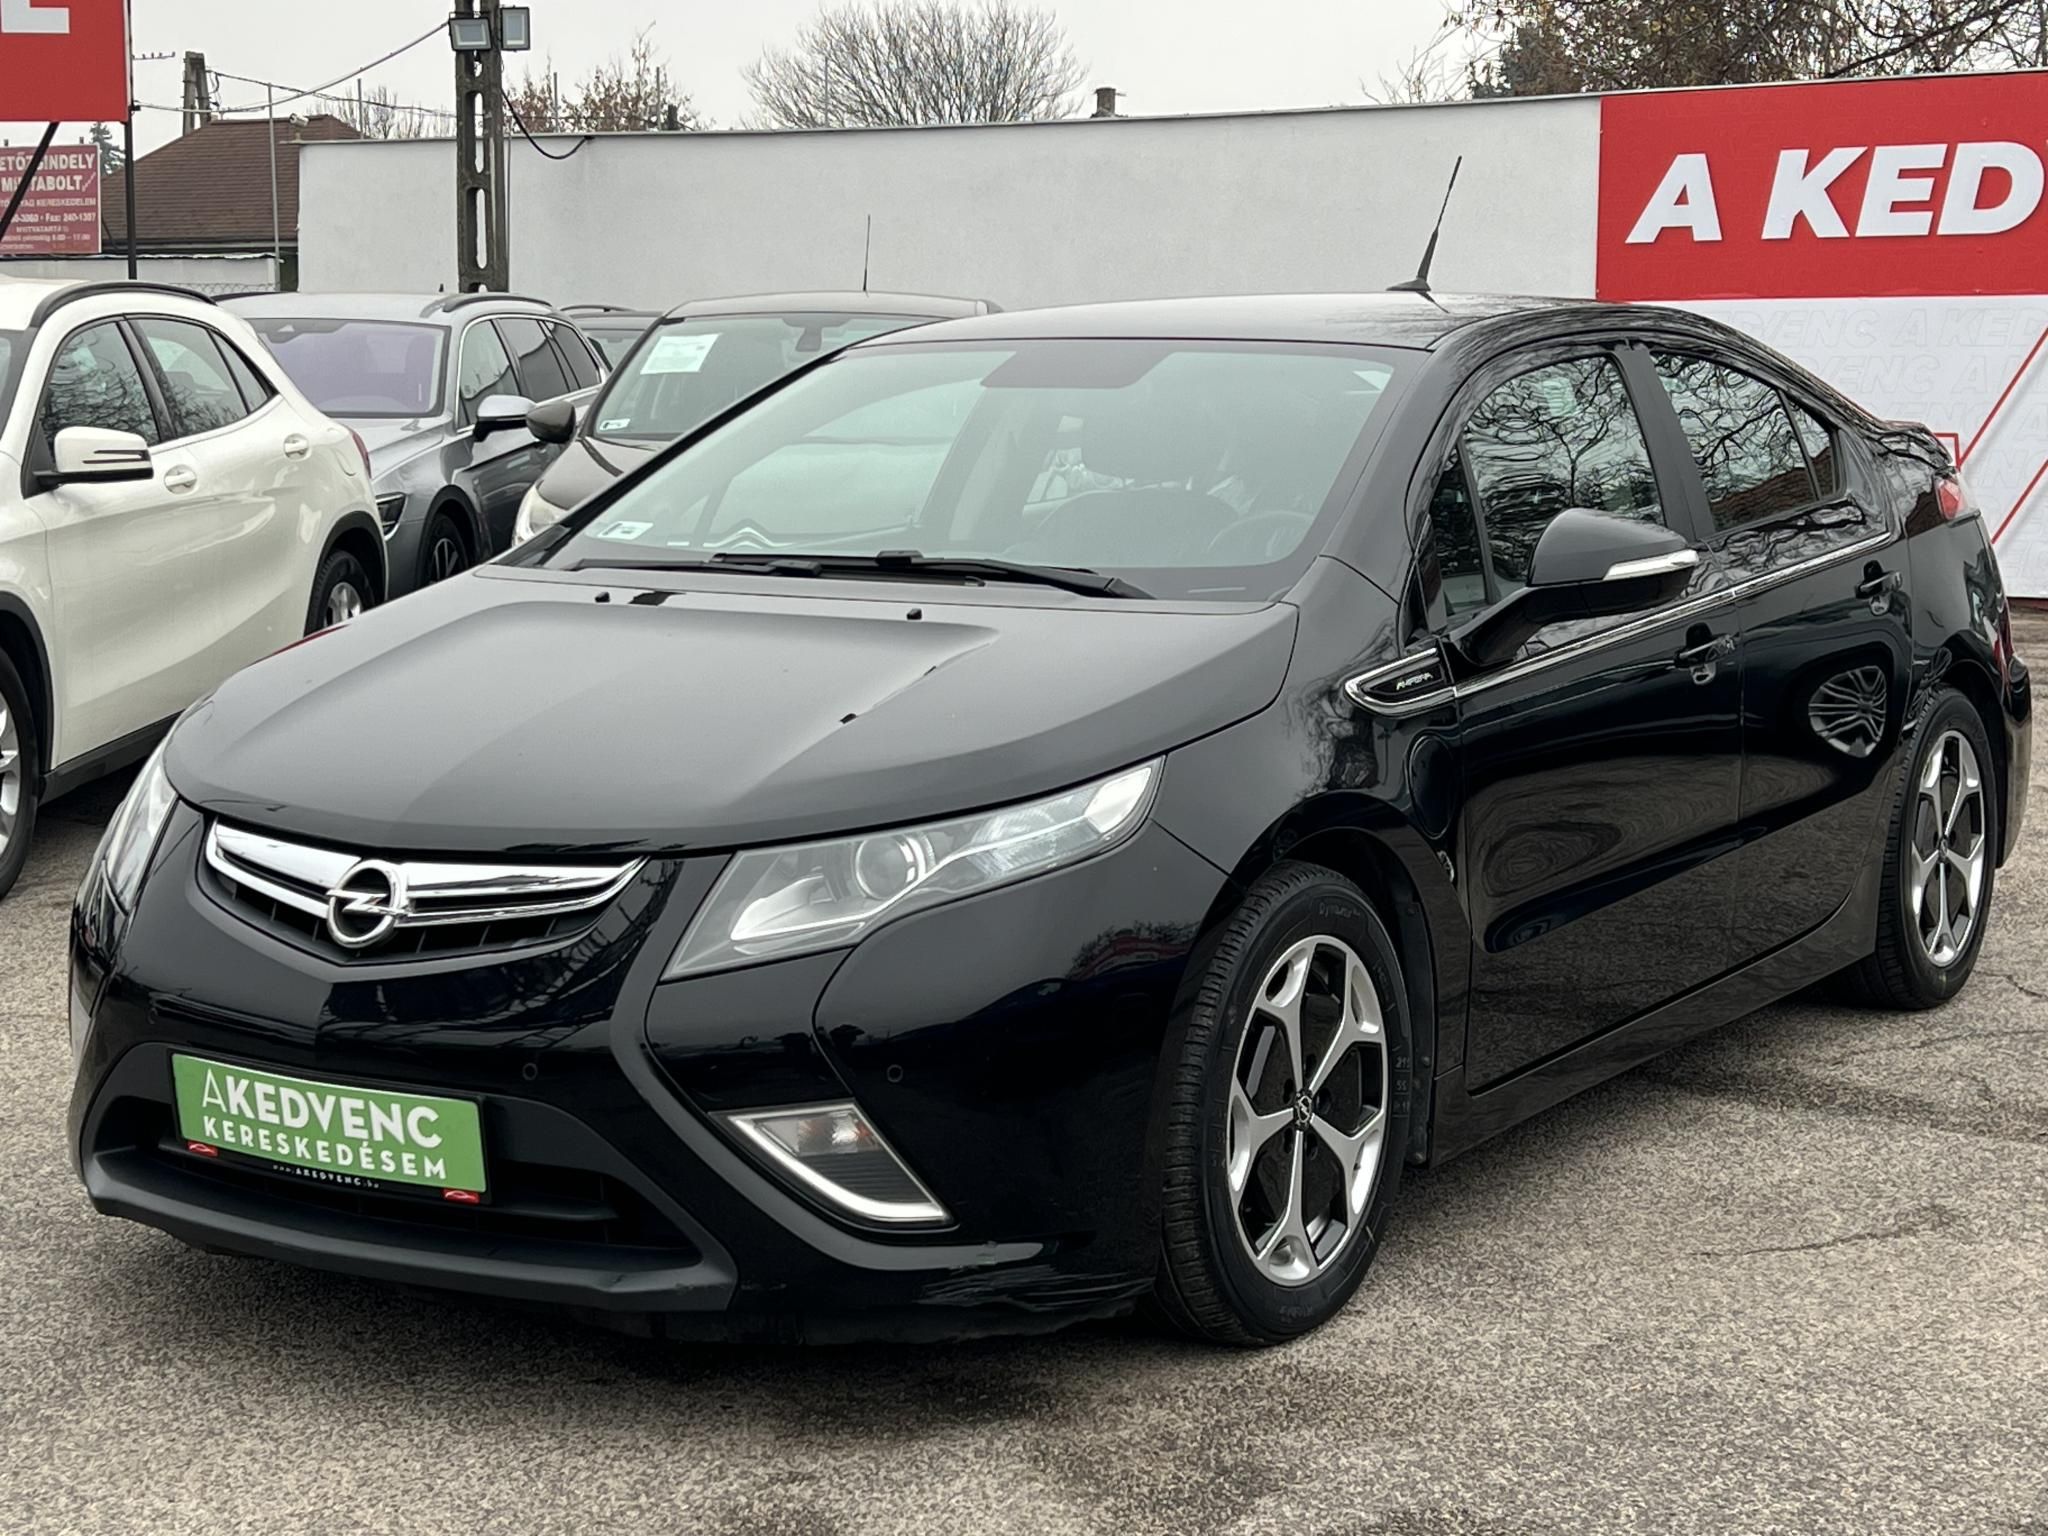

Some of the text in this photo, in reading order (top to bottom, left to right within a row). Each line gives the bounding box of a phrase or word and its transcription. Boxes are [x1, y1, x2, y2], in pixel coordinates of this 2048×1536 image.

[1625, 141, 2048, 243] A KED
[203, 1115, 446, 1180] KERESKEDÉSEM
